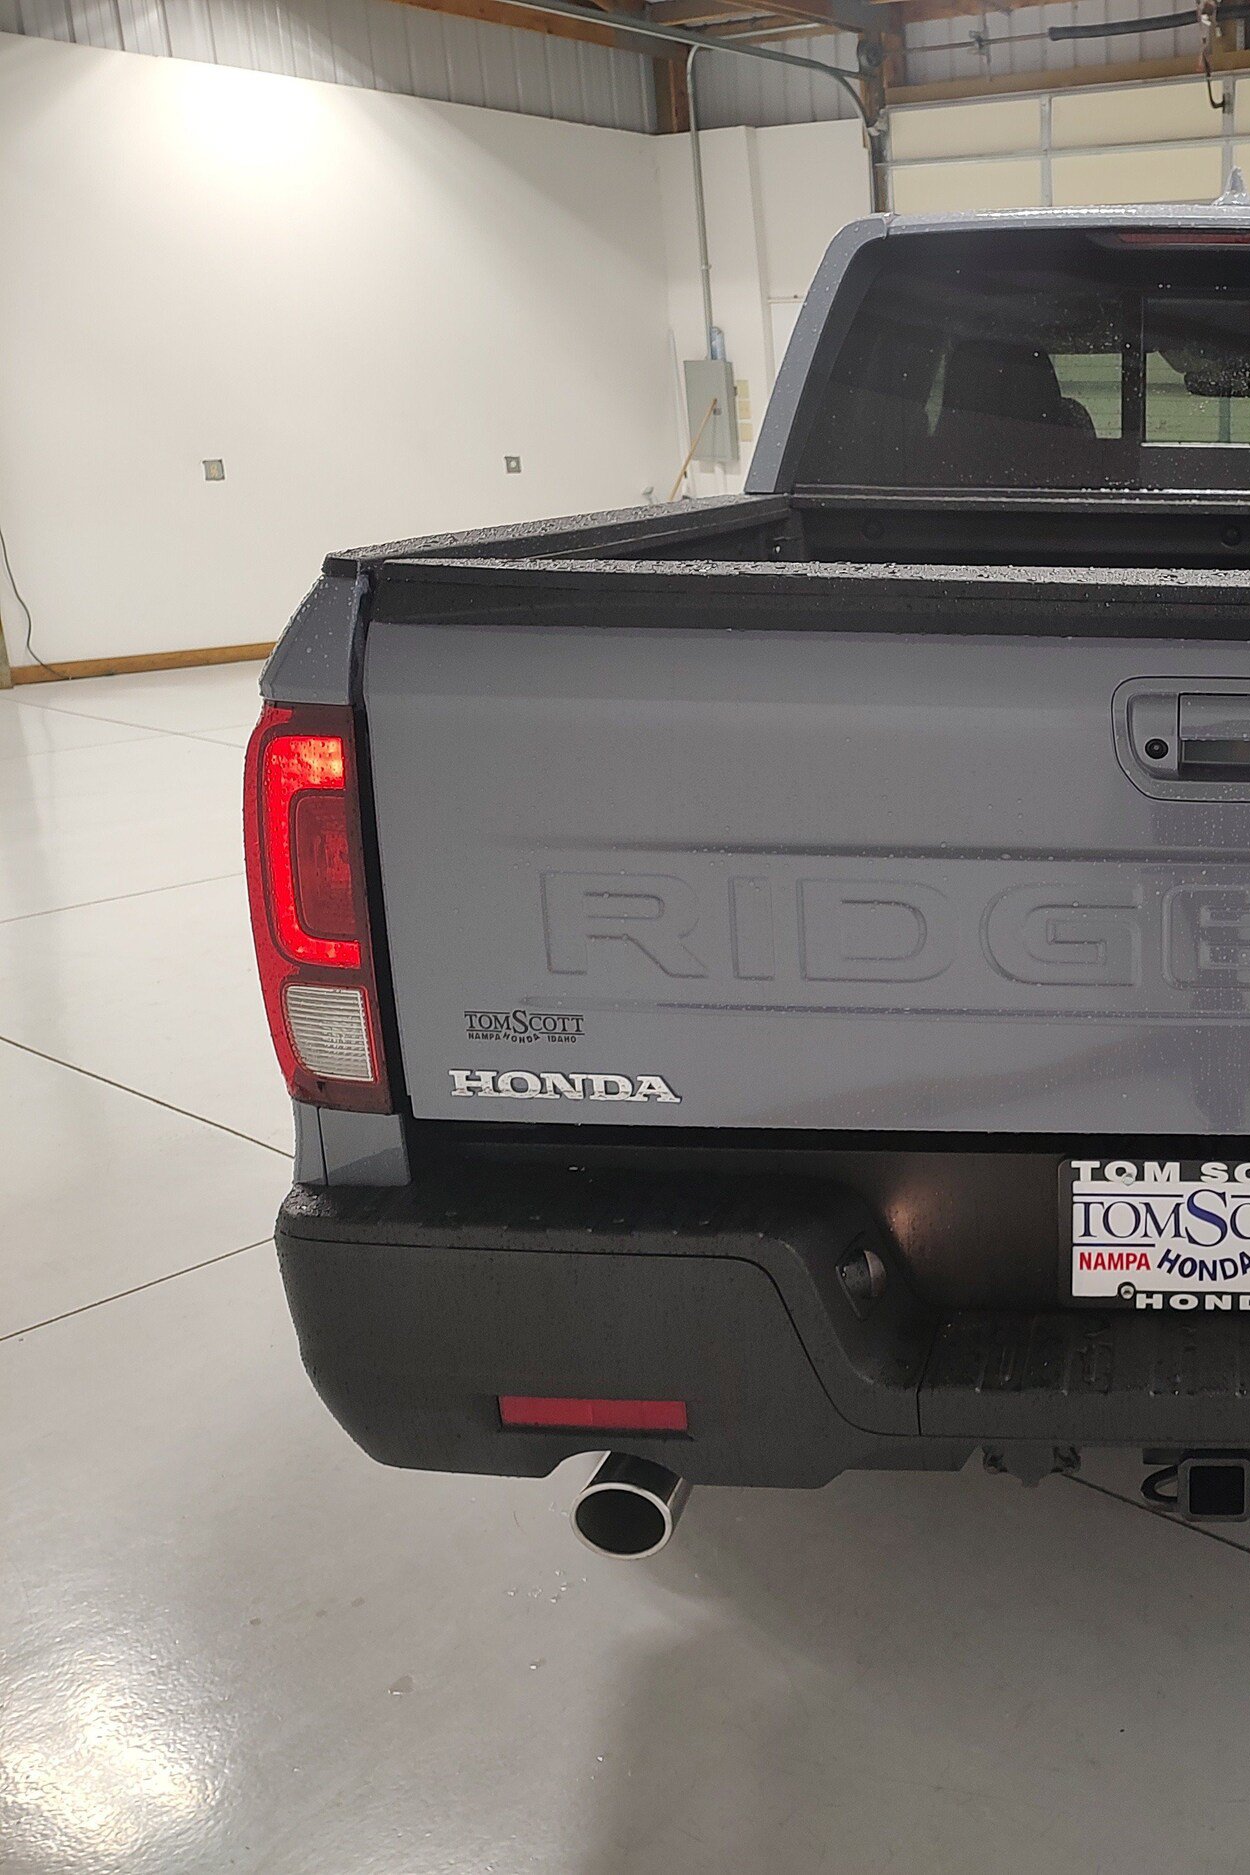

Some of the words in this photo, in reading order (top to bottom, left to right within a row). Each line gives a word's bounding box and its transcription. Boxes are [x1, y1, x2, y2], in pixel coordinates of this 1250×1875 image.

[468, 1032, 501, 1041] NAMPA
[502, 1031, 541, 1044] HONDA
[547, 1035, 577, 1044] IDAHO
[449, 1069, 682, 1103] HONDA
[1071, 1161, 1181, 1184] TOM
[1079, 1252, 1151, 1272] NAMPA
